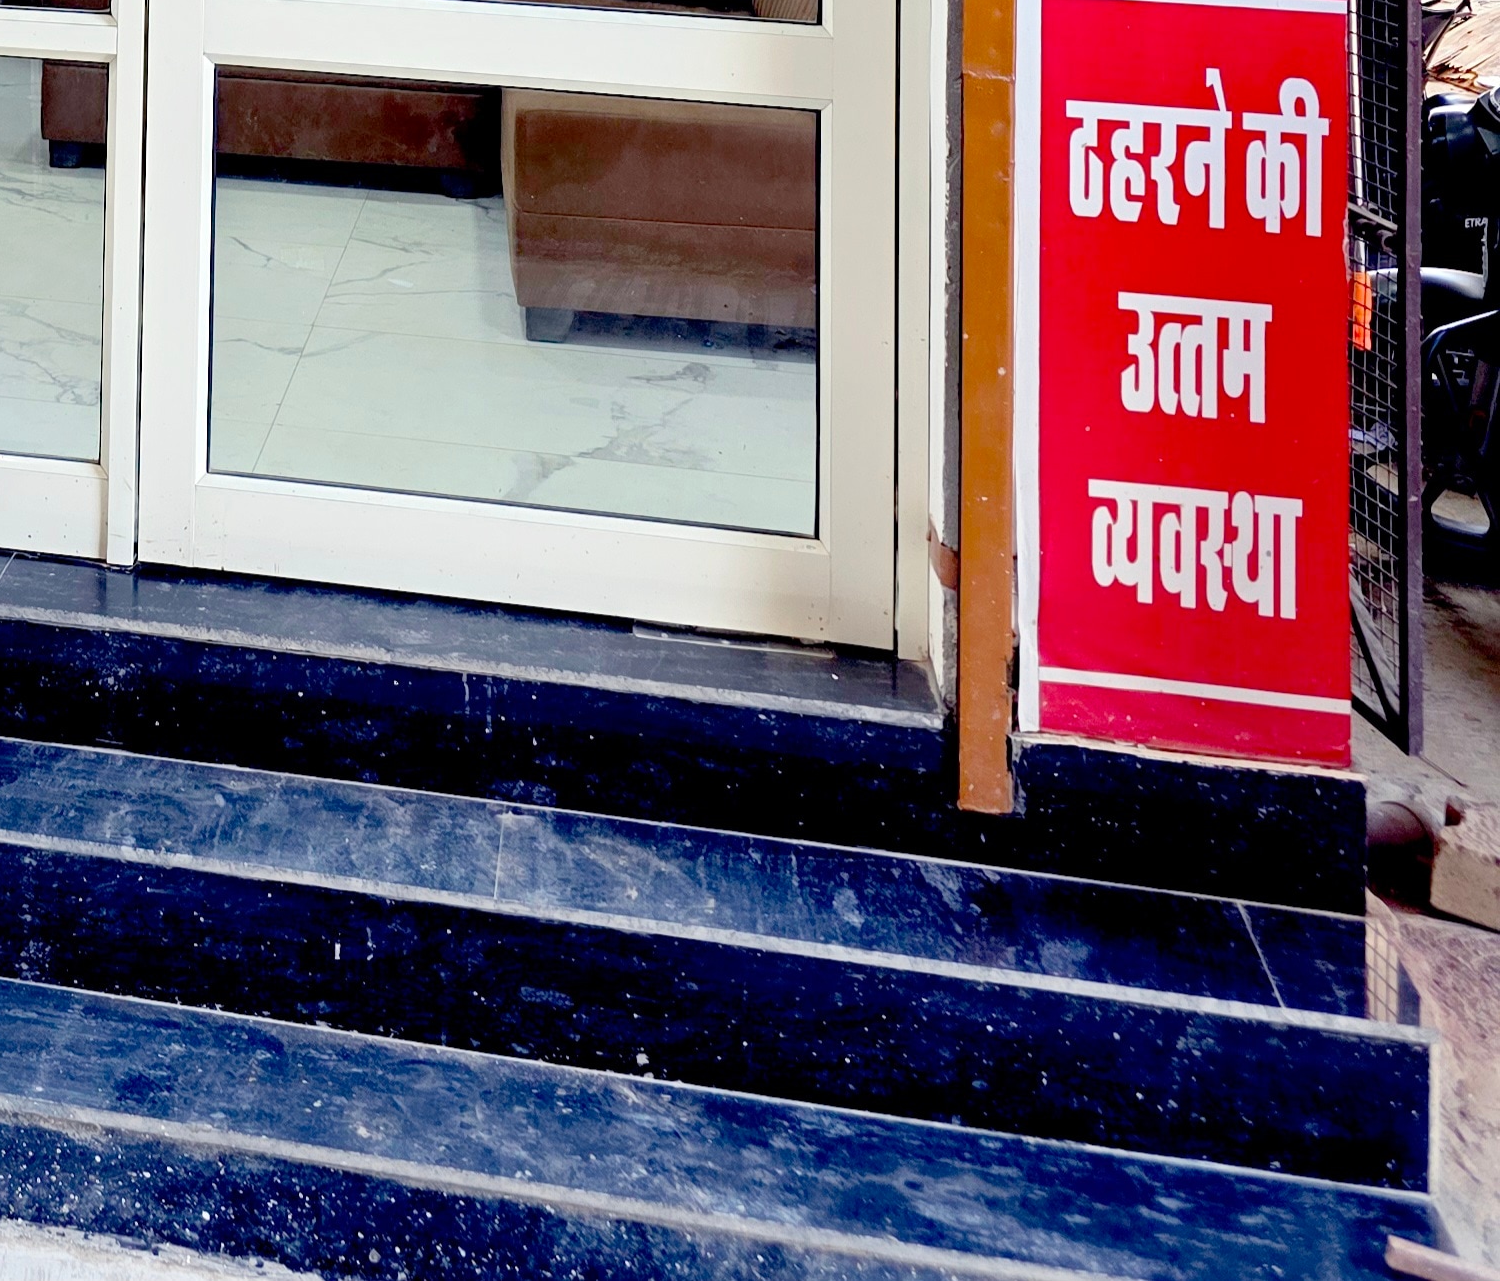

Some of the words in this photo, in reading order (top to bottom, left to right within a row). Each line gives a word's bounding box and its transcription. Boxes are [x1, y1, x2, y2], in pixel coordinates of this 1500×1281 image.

[1066, 67, 1232, 230] ठहरने
[1242, 77, 1329, 238] की
[1118, 291, 1273, 424] उत्तम
[1088, 478, 1303, 620] व्यवस्था
